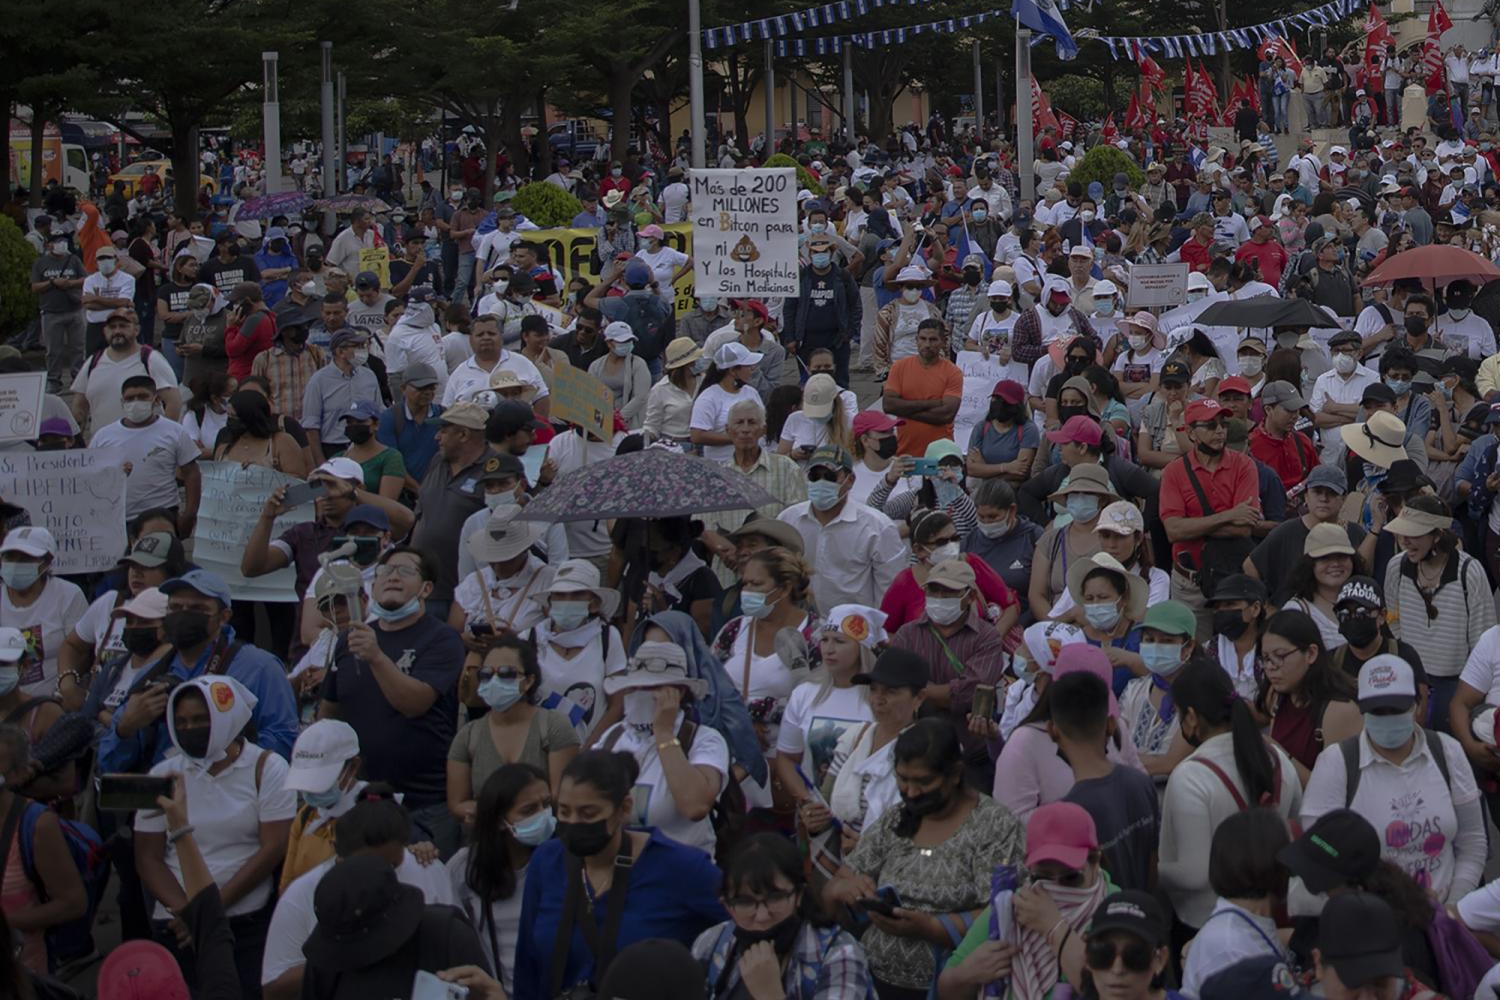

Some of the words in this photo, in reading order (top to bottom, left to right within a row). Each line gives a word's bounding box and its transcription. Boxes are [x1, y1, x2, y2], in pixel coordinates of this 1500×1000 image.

[695, 177, 724, 195] Más
[730, 176, 747, 195] de
[752, 175, 787, 194] 200
[713, 199, 780, 213] MILLONES
[698, 216, 715, 228] en
[766, 222, 794, 240] para
[715, 241, 727, 256] ni
[702, 261, 712, 275] Y
[719, 260, 736, 276] los
[744, 261, 798, 281] Hospitales
[718, 280, 741, 292] Sin
[747, 280, 795, 293] Medicinas
[354, 313, 383, 325] VANS
